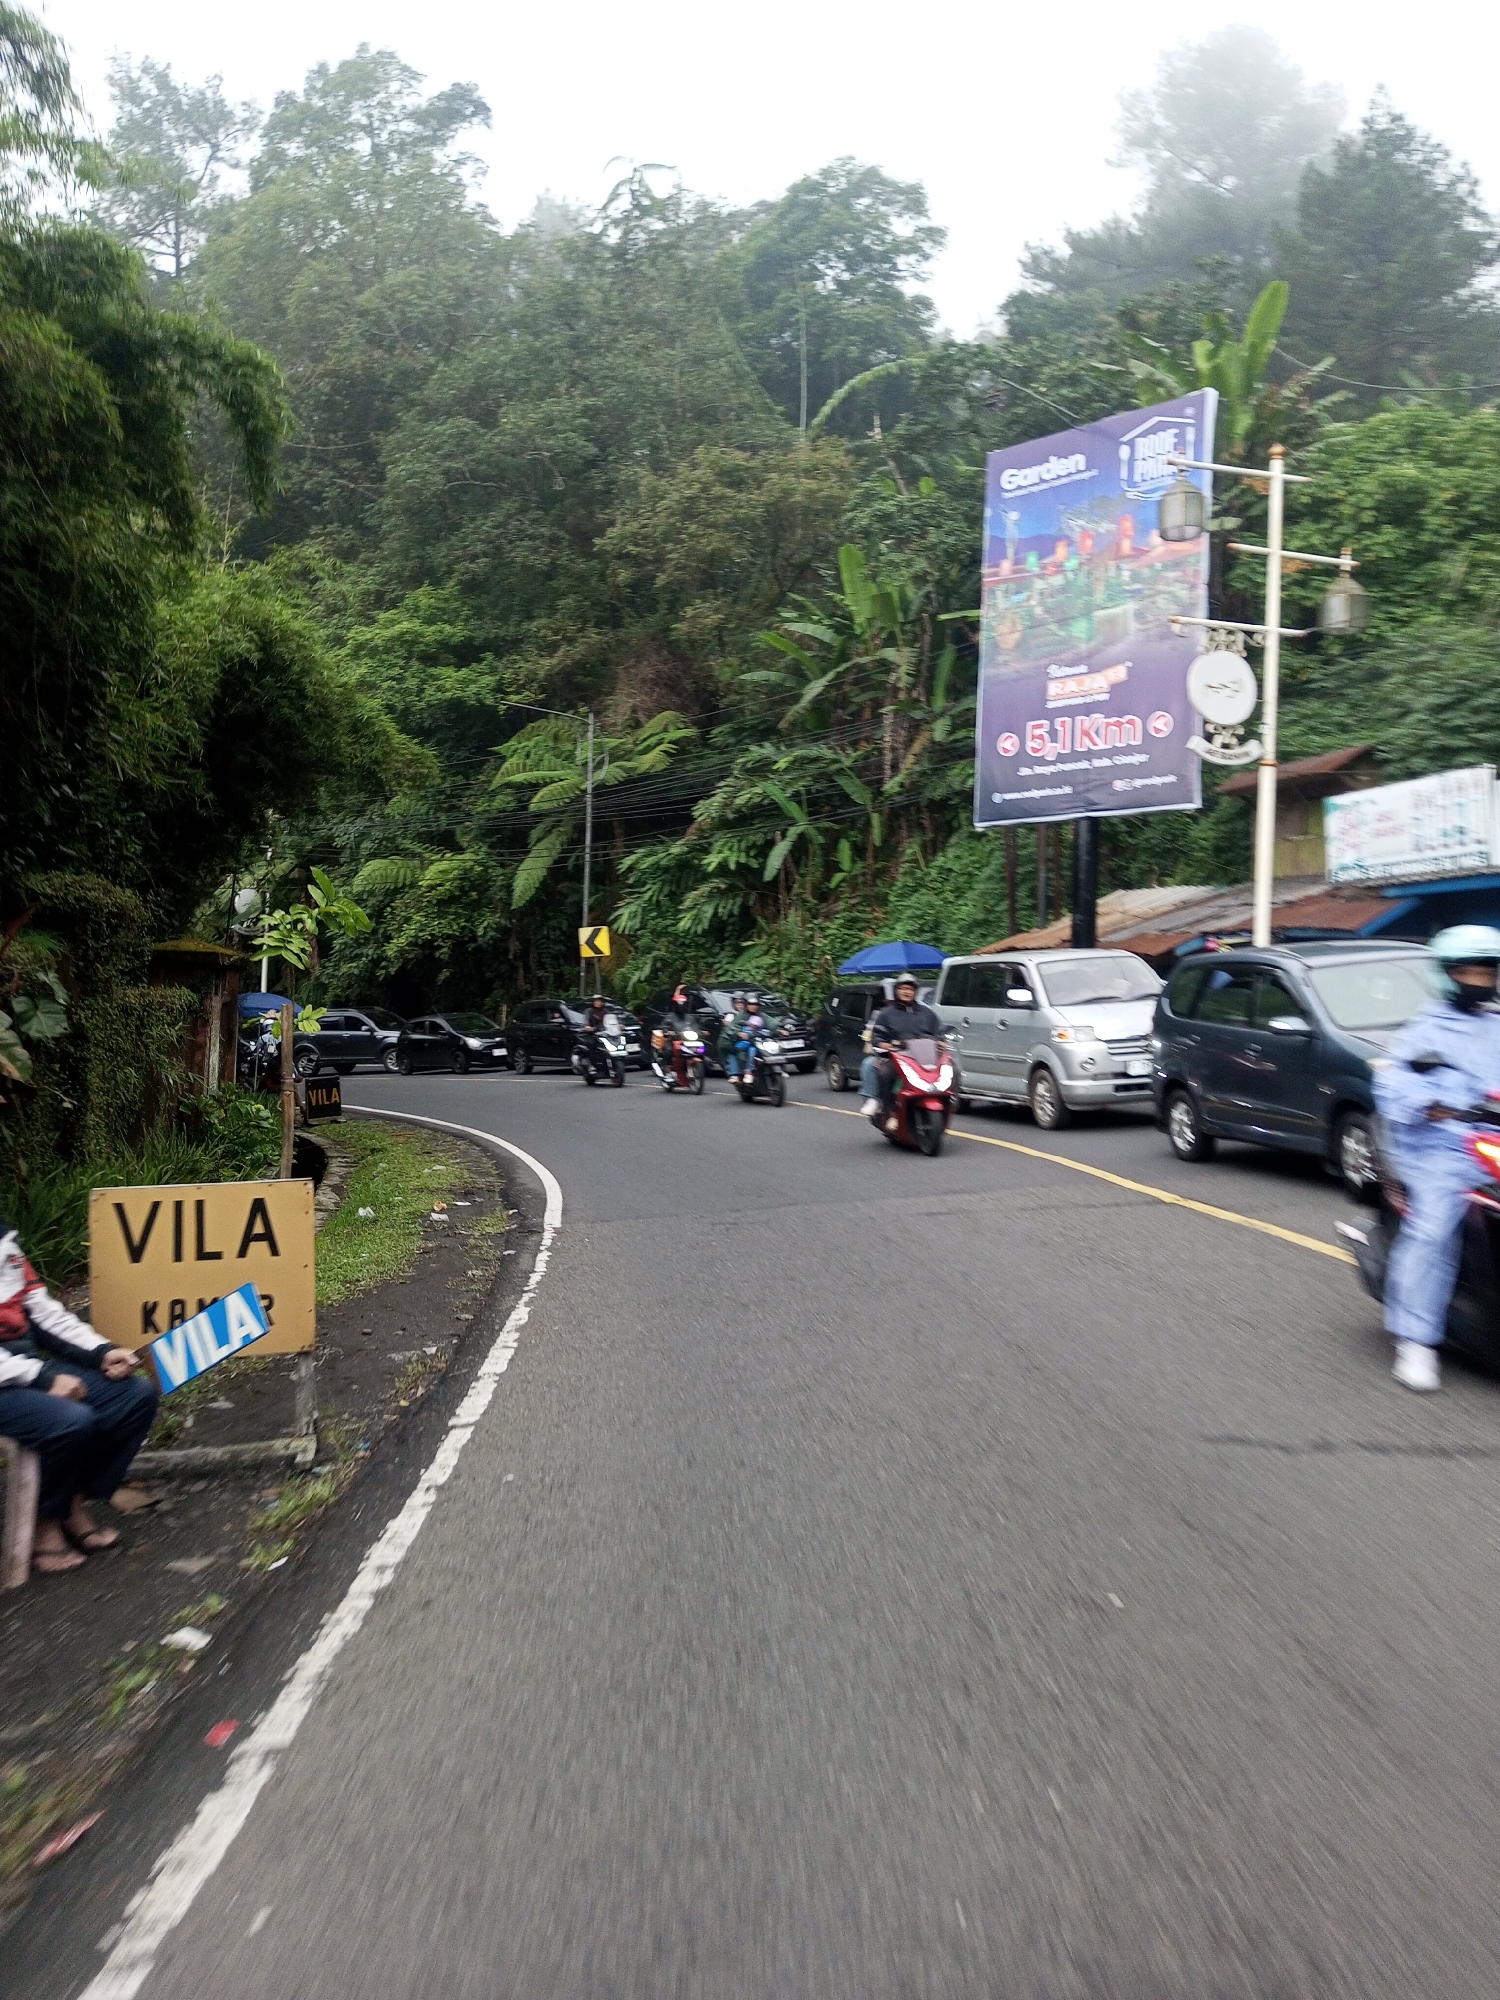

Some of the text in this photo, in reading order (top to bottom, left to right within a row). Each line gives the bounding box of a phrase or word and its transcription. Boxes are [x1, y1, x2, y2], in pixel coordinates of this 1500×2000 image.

[1000, 452, 1087, 491] Garden
[308, 1087, 341, 1106] VILA
[112, 1197, 281, 1264] VILA
[141, 1293, 276, 1335] KAR
[152, 1290, 266, 1388] VILA
